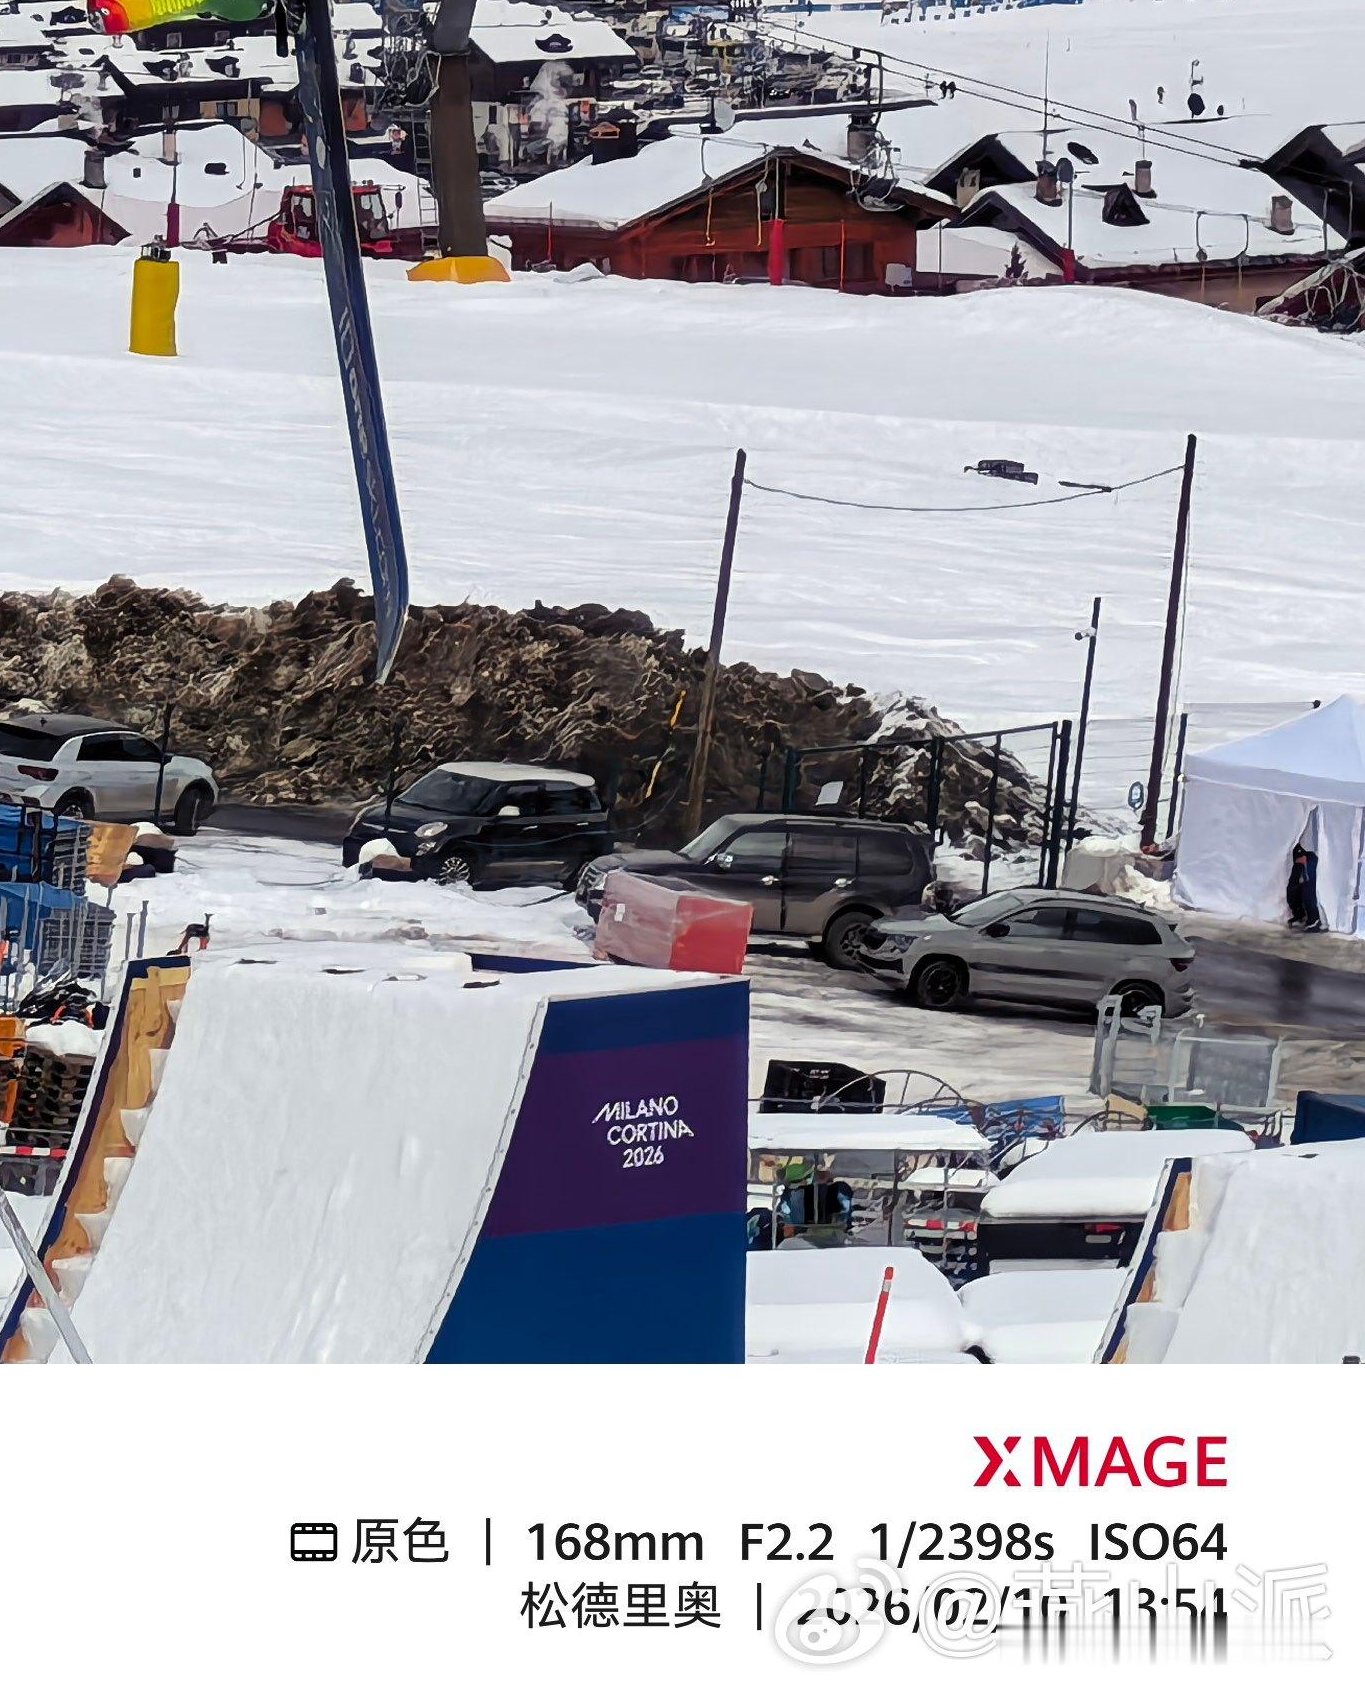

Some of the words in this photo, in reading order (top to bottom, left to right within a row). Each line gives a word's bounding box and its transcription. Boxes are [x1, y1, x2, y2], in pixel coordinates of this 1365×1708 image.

[591, 1096, 679, 1124] MILANO
[607, 1119, 695, 1146] CORTINA
[622, 1145, 665, 1169] 2026
